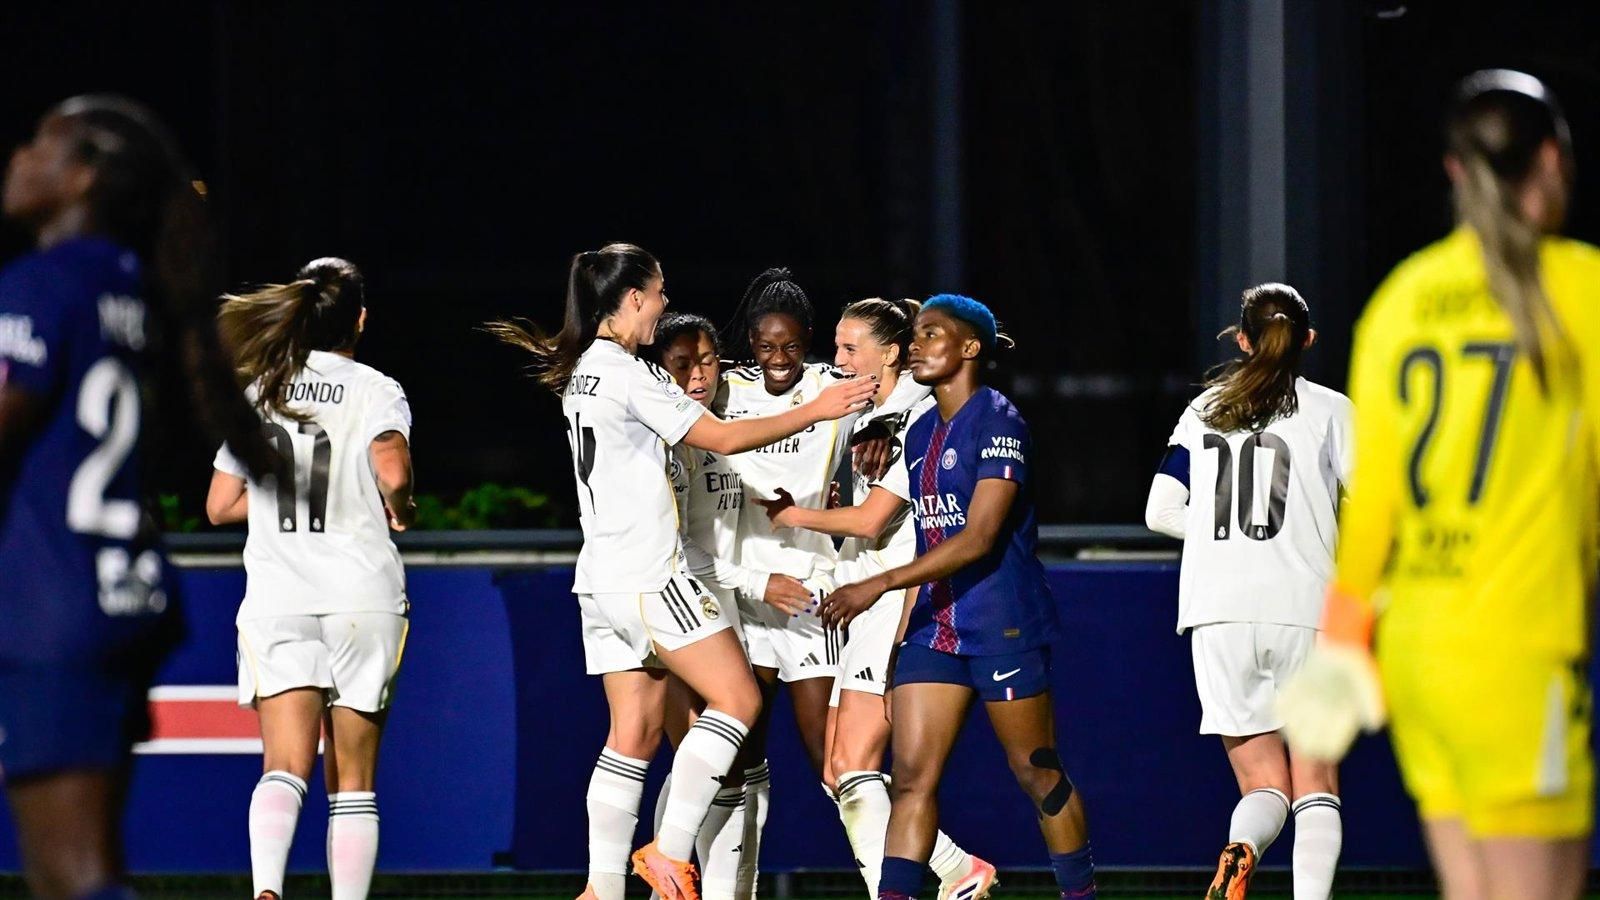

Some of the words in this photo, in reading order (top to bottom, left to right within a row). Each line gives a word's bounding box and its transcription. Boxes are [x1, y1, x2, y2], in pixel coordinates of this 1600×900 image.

[68, 357, 141, 541] 2
[981, 446, 1025, 464] RWANDA
[991, 436, 1021, 450] VISIT
[1399, 340, 1516, 508] 27
[1203, 431, 1291, 541] 10
[920, 512, 966, 530] AIRWAYS
